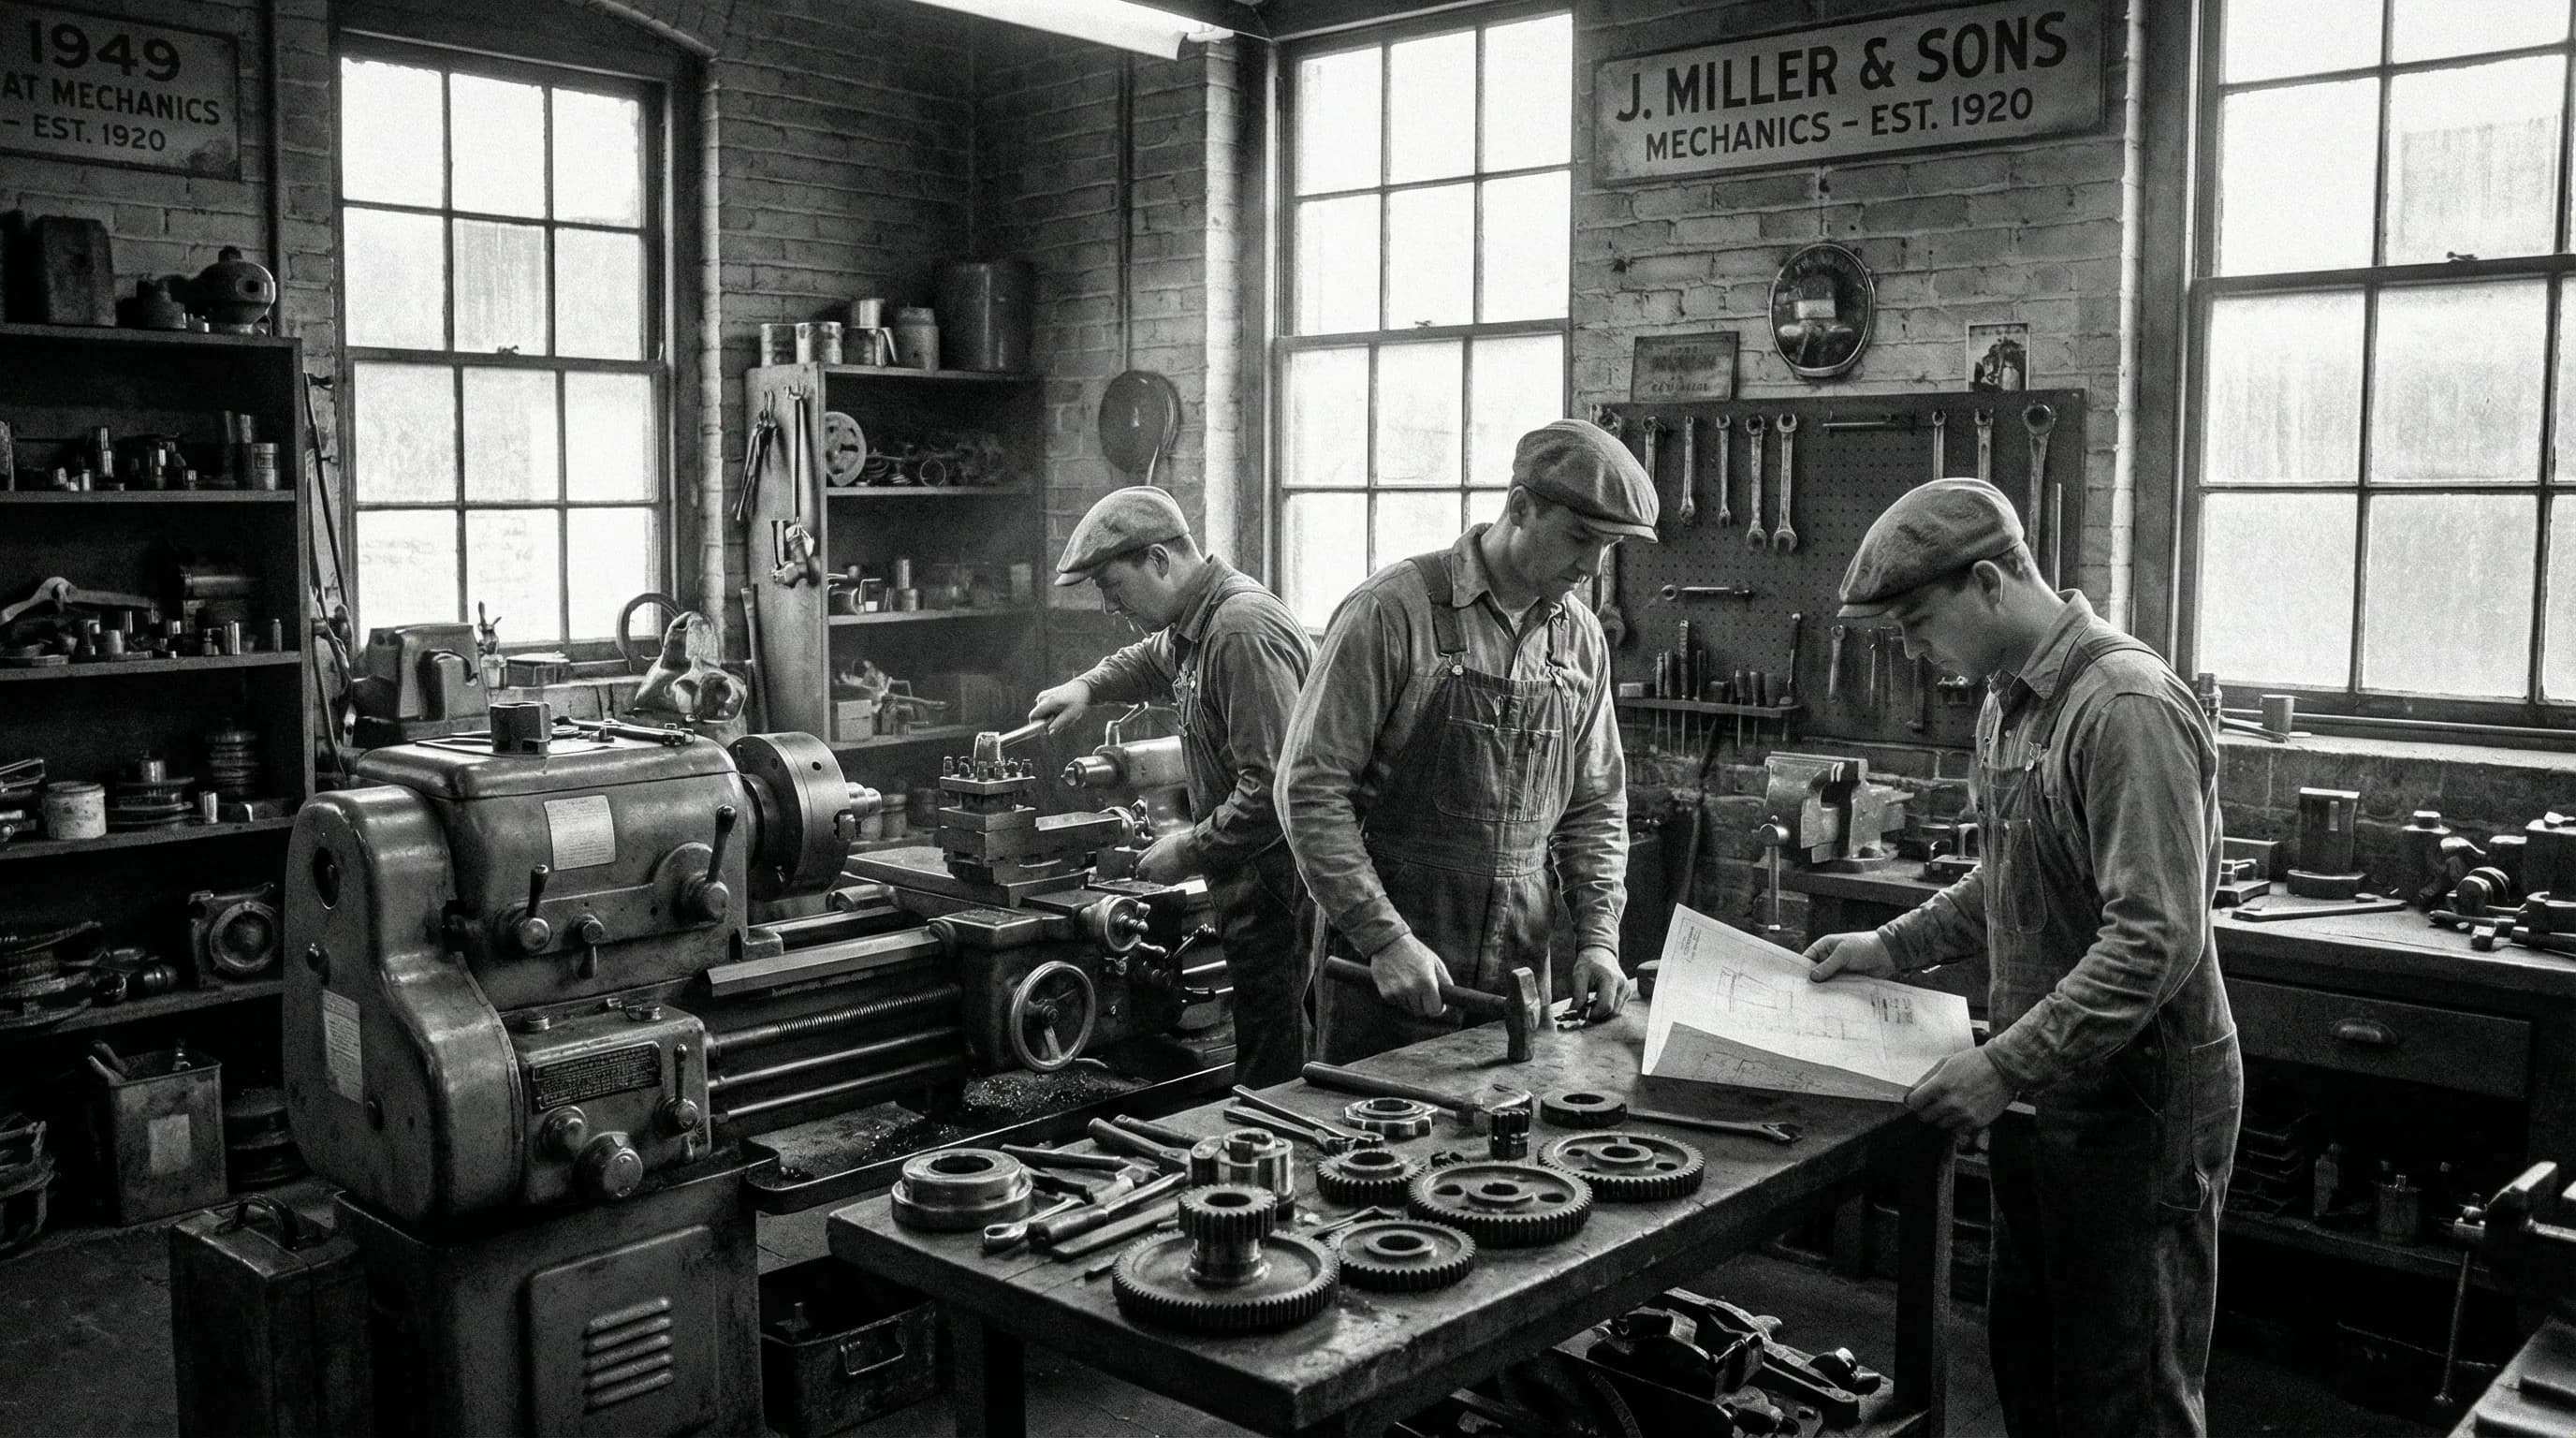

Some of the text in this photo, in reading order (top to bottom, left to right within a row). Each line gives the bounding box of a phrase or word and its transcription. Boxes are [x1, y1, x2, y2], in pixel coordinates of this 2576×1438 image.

[26, 19, 181, 81] 1949
[1616, 11, 2068, 123] J. MILLER & SONS
[2, 71, 220, 125] AT MECHANICS
[1646, 111, 1831, 162] MECHANICS
[1871, 98, 1938, 137] EST.
[1951, 87, 2033, 126] 1920
[35, 114, 92, 143] EST.
[103, 123, 166, 152] 1920
